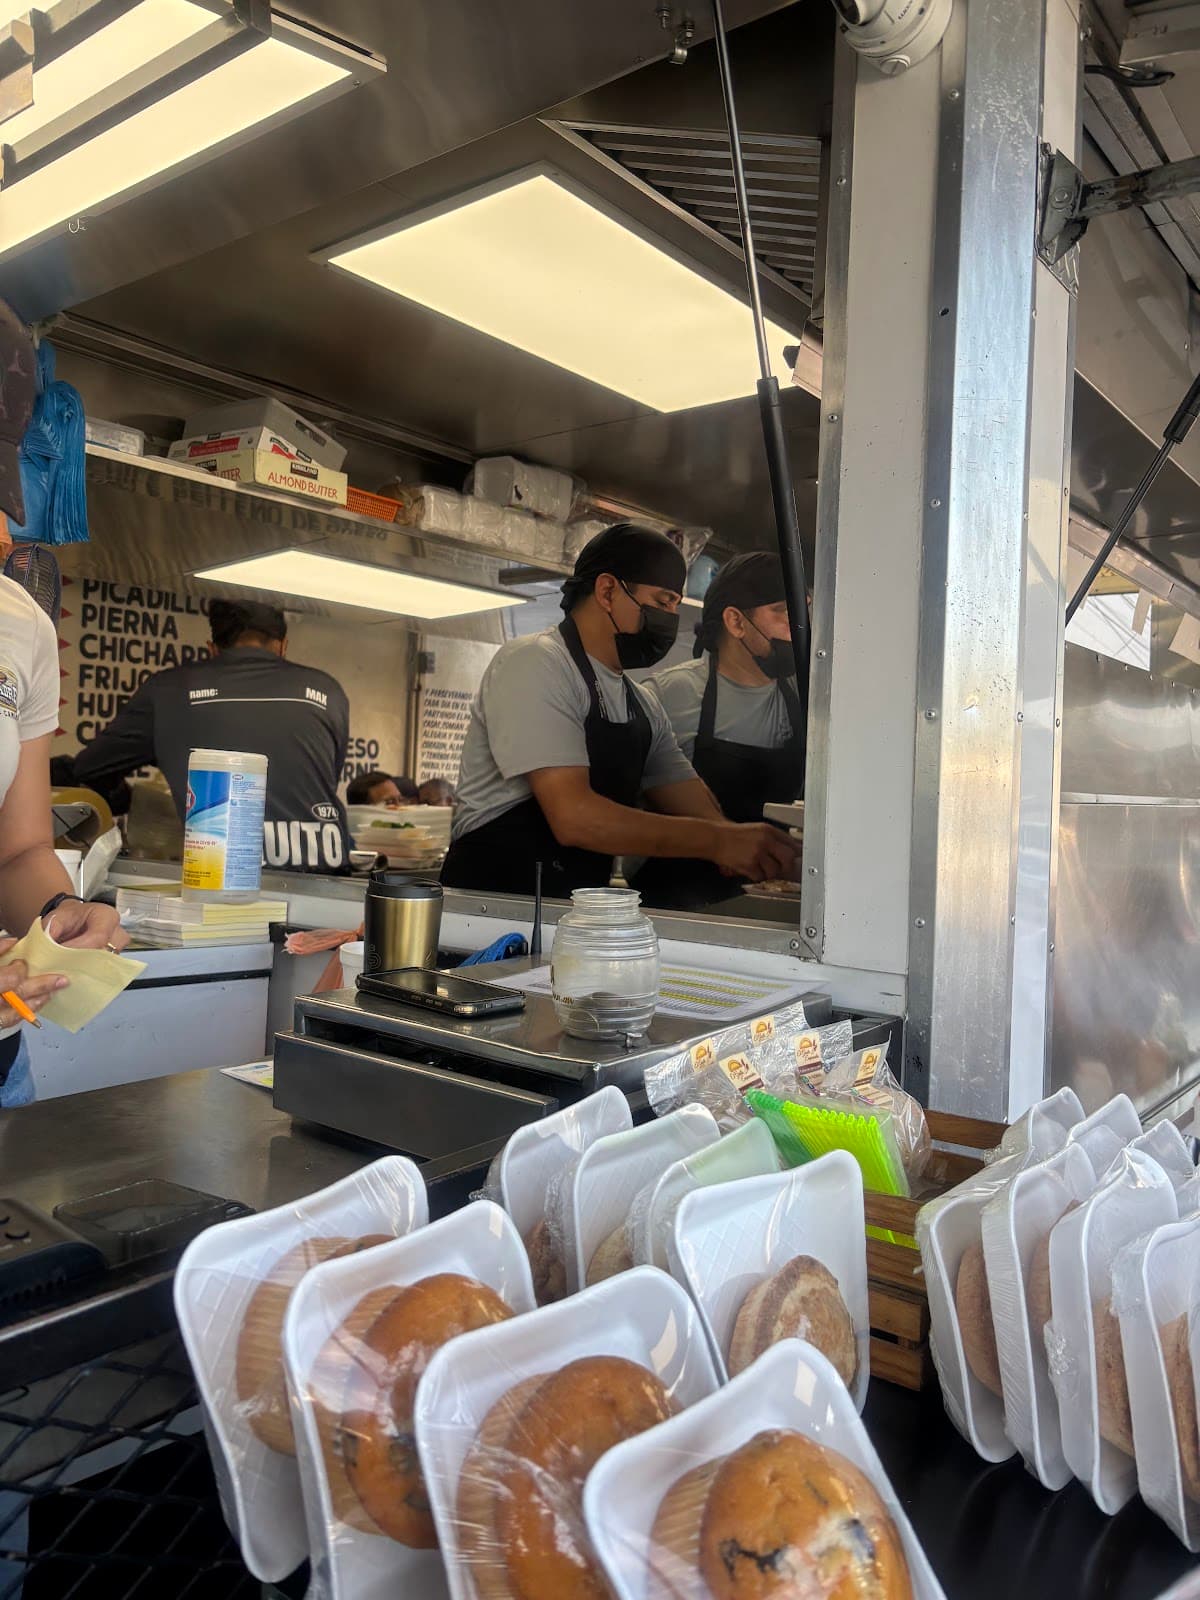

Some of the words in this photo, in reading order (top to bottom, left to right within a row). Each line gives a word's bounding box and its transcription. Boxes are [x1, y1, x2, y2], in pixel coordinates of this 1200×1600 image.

[268, 472, 307, 492] ALMOND
[308, 481, 337, 499] BUTTER
[80, 603, 179, 640] PIERNA
[188, 687, 219, 700] name:
[305, 687, 328, 706] MAX
[262, 821, 343, 868] UITO
